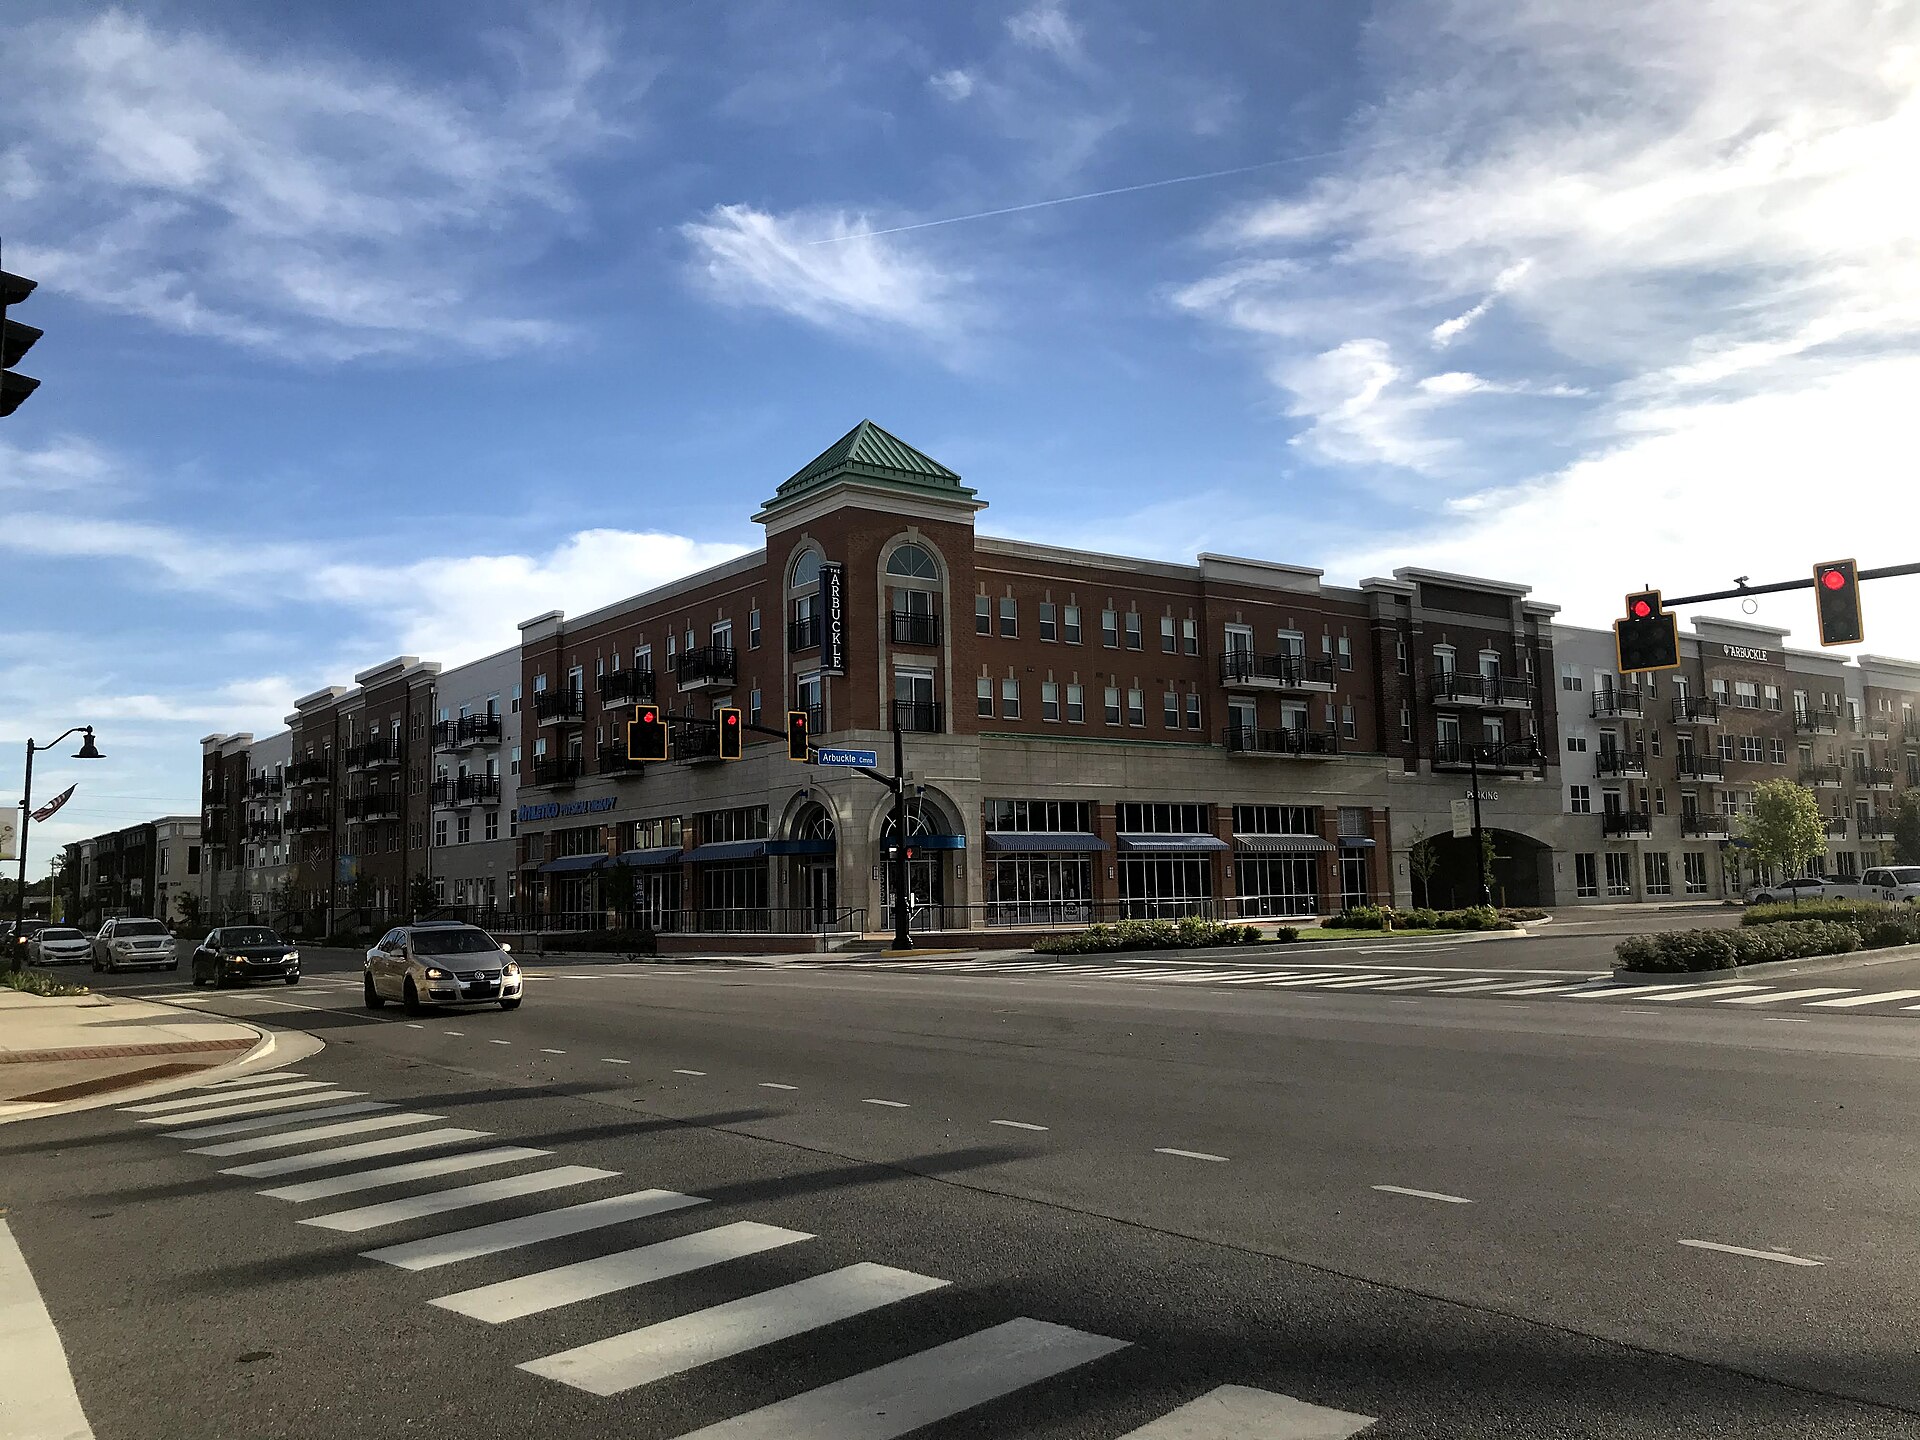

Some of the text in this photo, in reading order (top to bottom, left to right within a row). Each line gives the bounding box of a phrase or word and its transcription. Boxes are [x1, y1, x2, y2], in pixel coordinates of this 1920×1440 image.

[831, 574, 841, 668] ARBUCKLE
[1731, 646, 1768, 661] ARBUCKLE
[822, 752, 856, 763] Arbuckle
